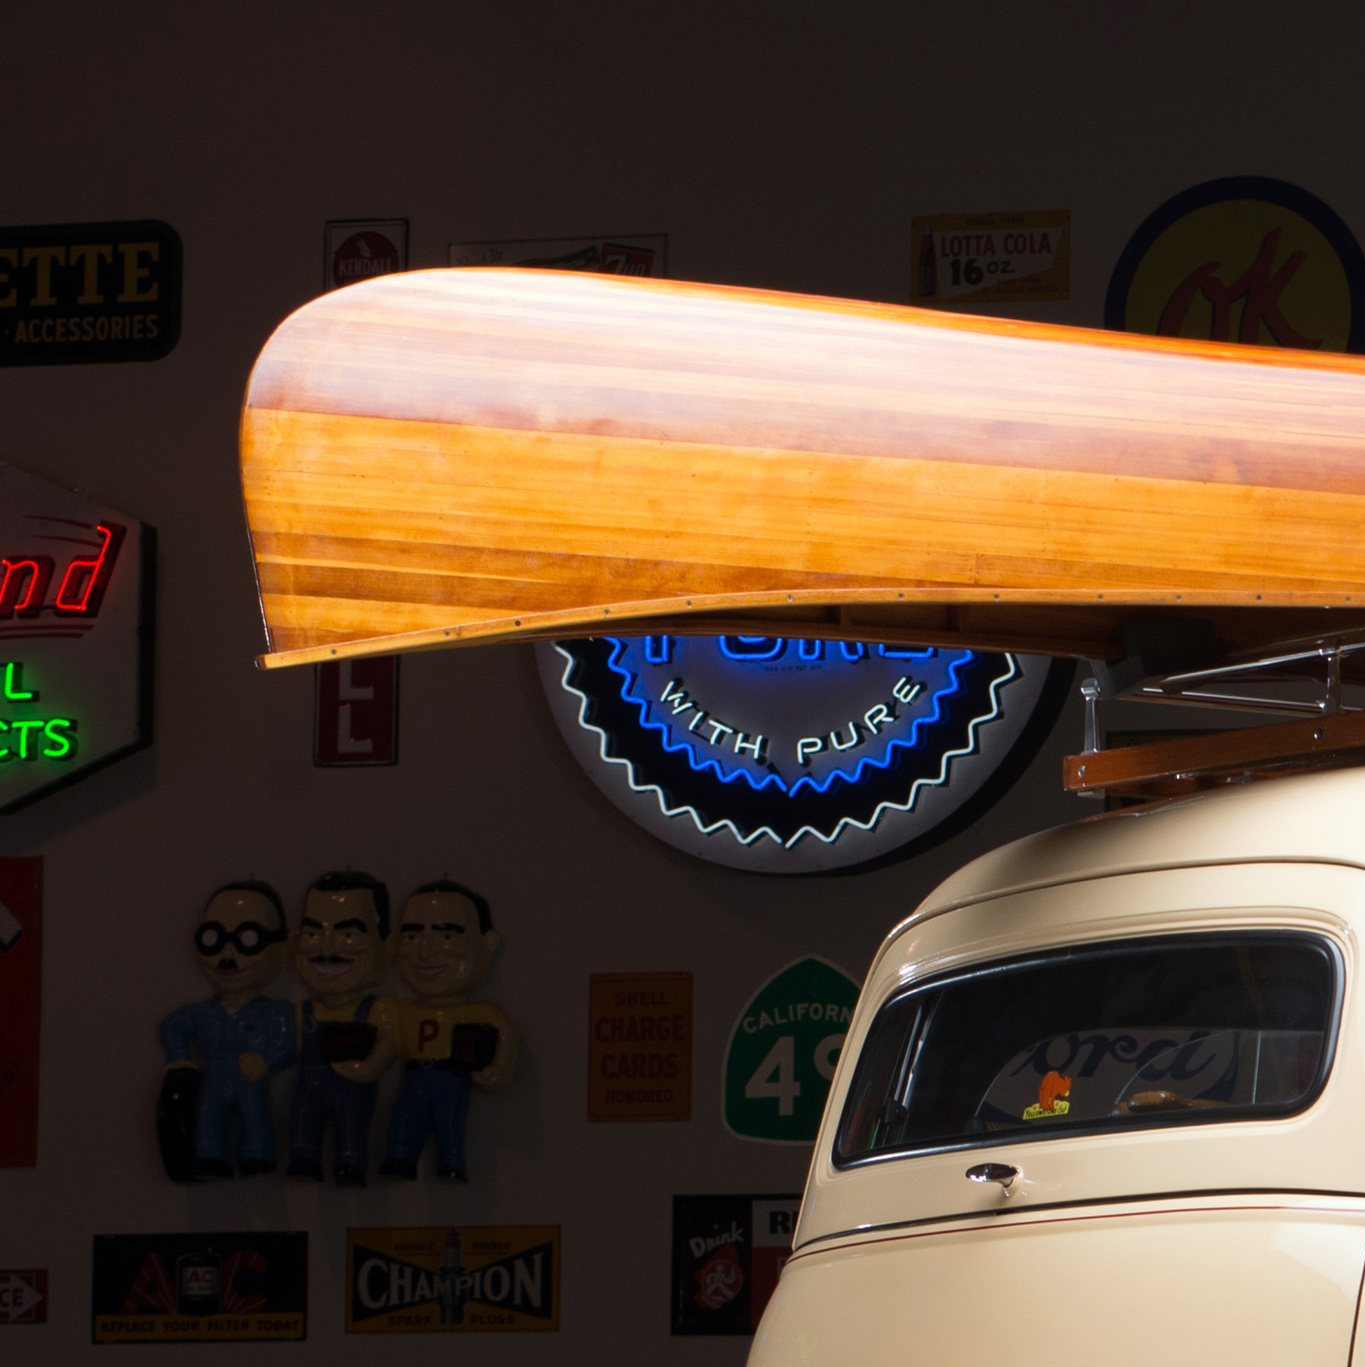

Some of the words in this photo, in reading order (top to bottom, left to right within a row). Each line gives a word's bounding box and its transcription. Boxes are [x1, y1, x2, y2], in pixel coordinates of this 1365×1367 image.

[941, 234, 996, 258] LOTTA
[1004, 232, 1052, 255] COLA
[339, 257, 392, 277] KENDALL
[950, 257, 984, 286] 16
[1156, 227, 1323, 349] OK
[13, 313, 159, 344] ACCESSORIES
[661, 680, 765, 760] WITH
[797, 676, 922, 765] PURE
[614, 991, 670, 1007] SHELL
[418, 1018, 440, 1054] P
[595, 1014, 685, 1043] CHARGE
[601, 1053, 679, 1080] CARDS
[1012, 1030, 1216, 1082] ord
[605, 1089, 675, 1105] HONORED
[688, 1220, 745, 1259] Drink
[187, 1266, 214, 1284] AC
[357, 1251, 547, 1310] CHAMPION
[101, 1320, 156, 1333] REPLACE
[163, 1320, 200, 1332] YOUR
[207, 1320, 250, 1332] FILTER
[256, 1319, 300, 1331] TODAY
[388, 1315, 433, 1326] SPARK
[470, 1314, 515, 1325] PLUGS
